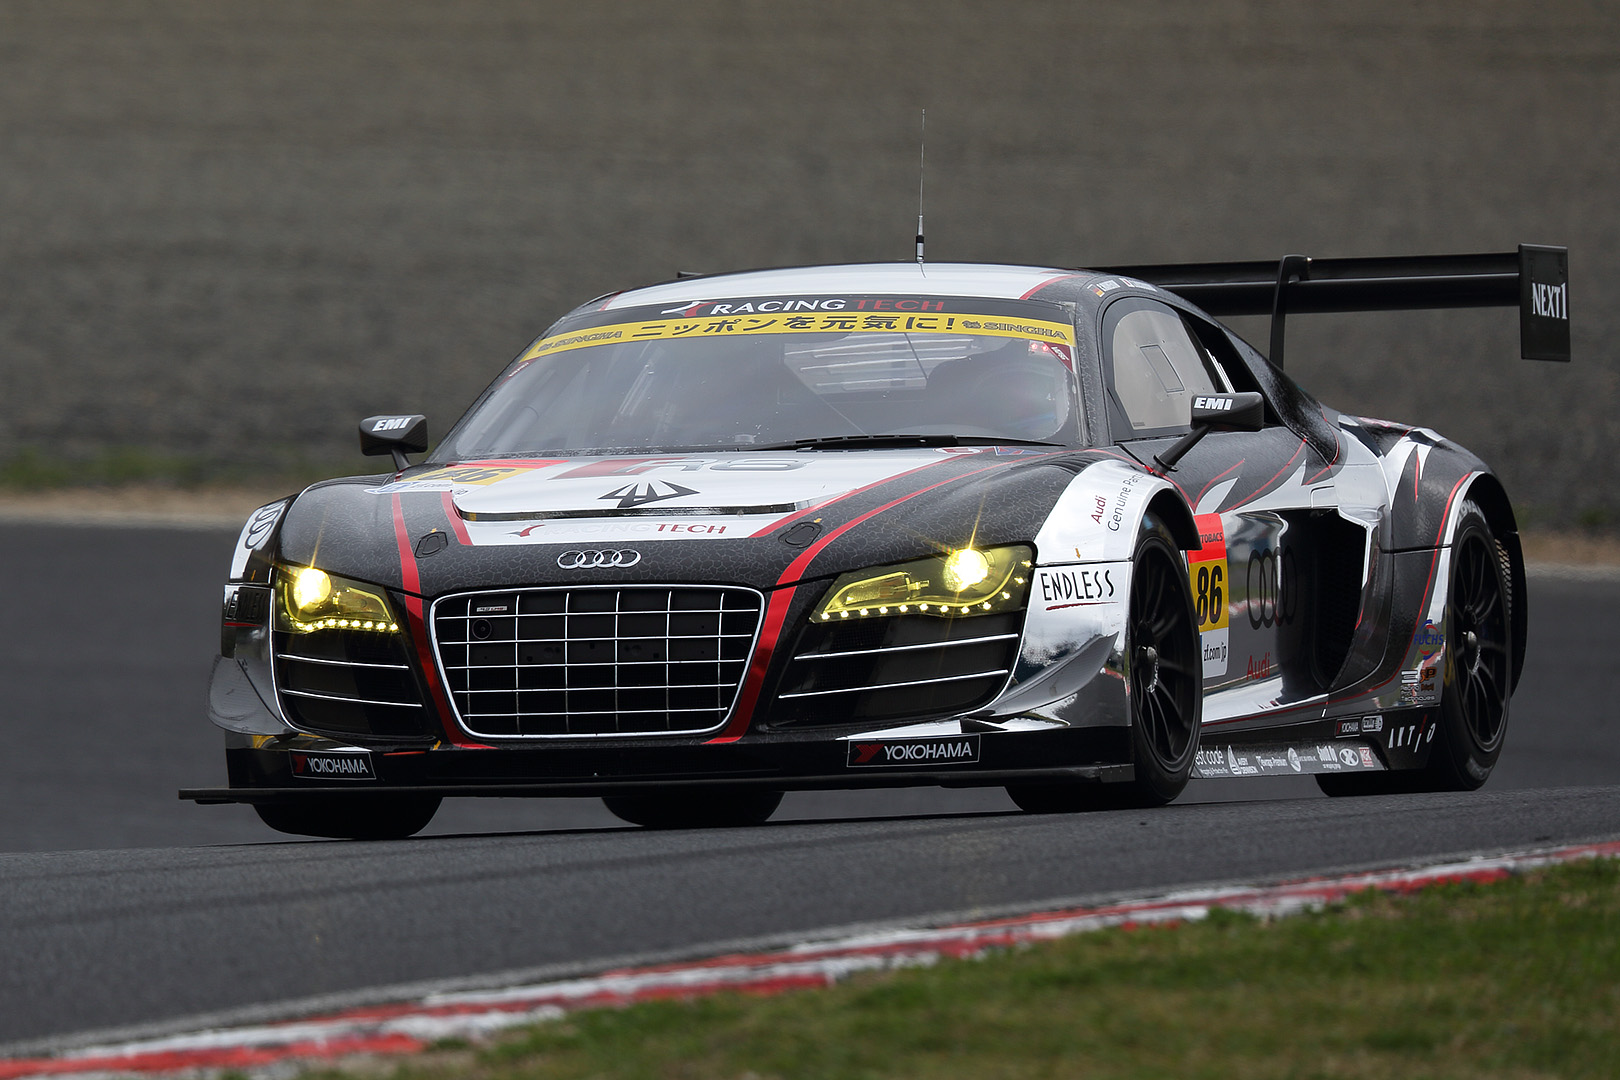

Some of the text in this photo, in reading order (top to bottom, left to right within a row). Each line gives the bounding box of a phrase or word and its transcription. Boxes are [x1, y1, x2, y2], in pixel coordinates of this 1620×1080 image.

[709, 299, 944, 315] RACING TECH
[1532, 282, 1567, 320] NEXT1
[983, 322, 1068, 340] SINGHA
[1194, 397, 1233, 411] EMI
[372, 417, 412, 432] EMI
[1091, 495, 1107, 525] Audi
[1107, 486, 1132, 532] Genuine
[656, 523, 727, 534] TECH
[1040, 569, 1115, 601] ENDLESS
[1197, 565, 1222, 626] 86
[1414, 634, 1444, 646] FUCHS
[1246, 652, 1271, 680] Audi
[884, 742, 973, 761] YOKOHAMA
[1206, 745, 1225, 765] code
[306, 757, 369, 774] YOKOHAMA
